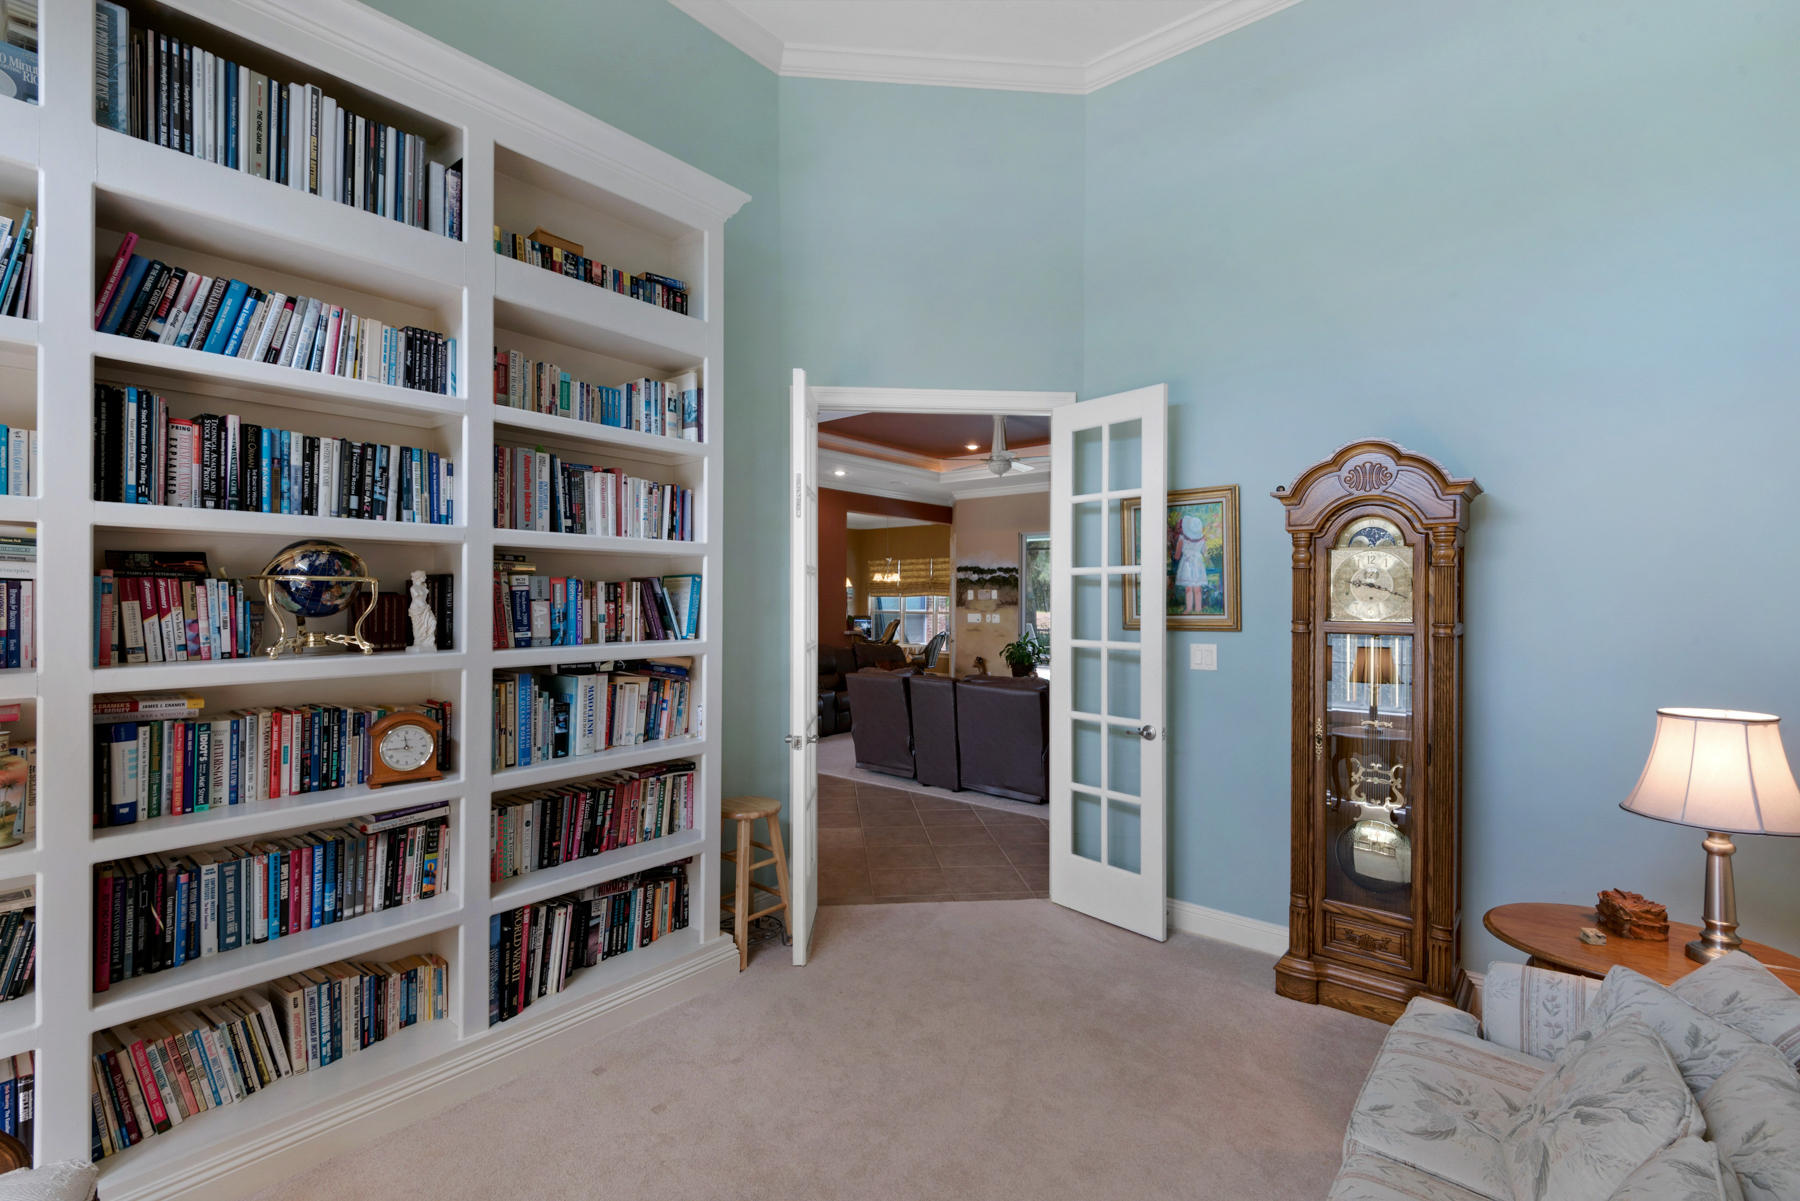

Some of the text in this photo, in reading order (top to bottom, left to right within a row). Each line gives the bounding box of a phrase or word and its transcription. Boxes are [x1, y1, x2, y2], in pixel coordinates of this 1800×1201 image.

[212, 279, 226, 298] PETER
[248, 426, 256, 468] SUZE ORMAN
[169, 438, 177, 495] EXPLAINED
[523, 455, 532, 490] Alternative
[200, 734, 208, 761] IDIOT'S
[280, 863, 289, 900] SUPER STOCKS
[512, 908, 523, 982] WORLD WAR II
